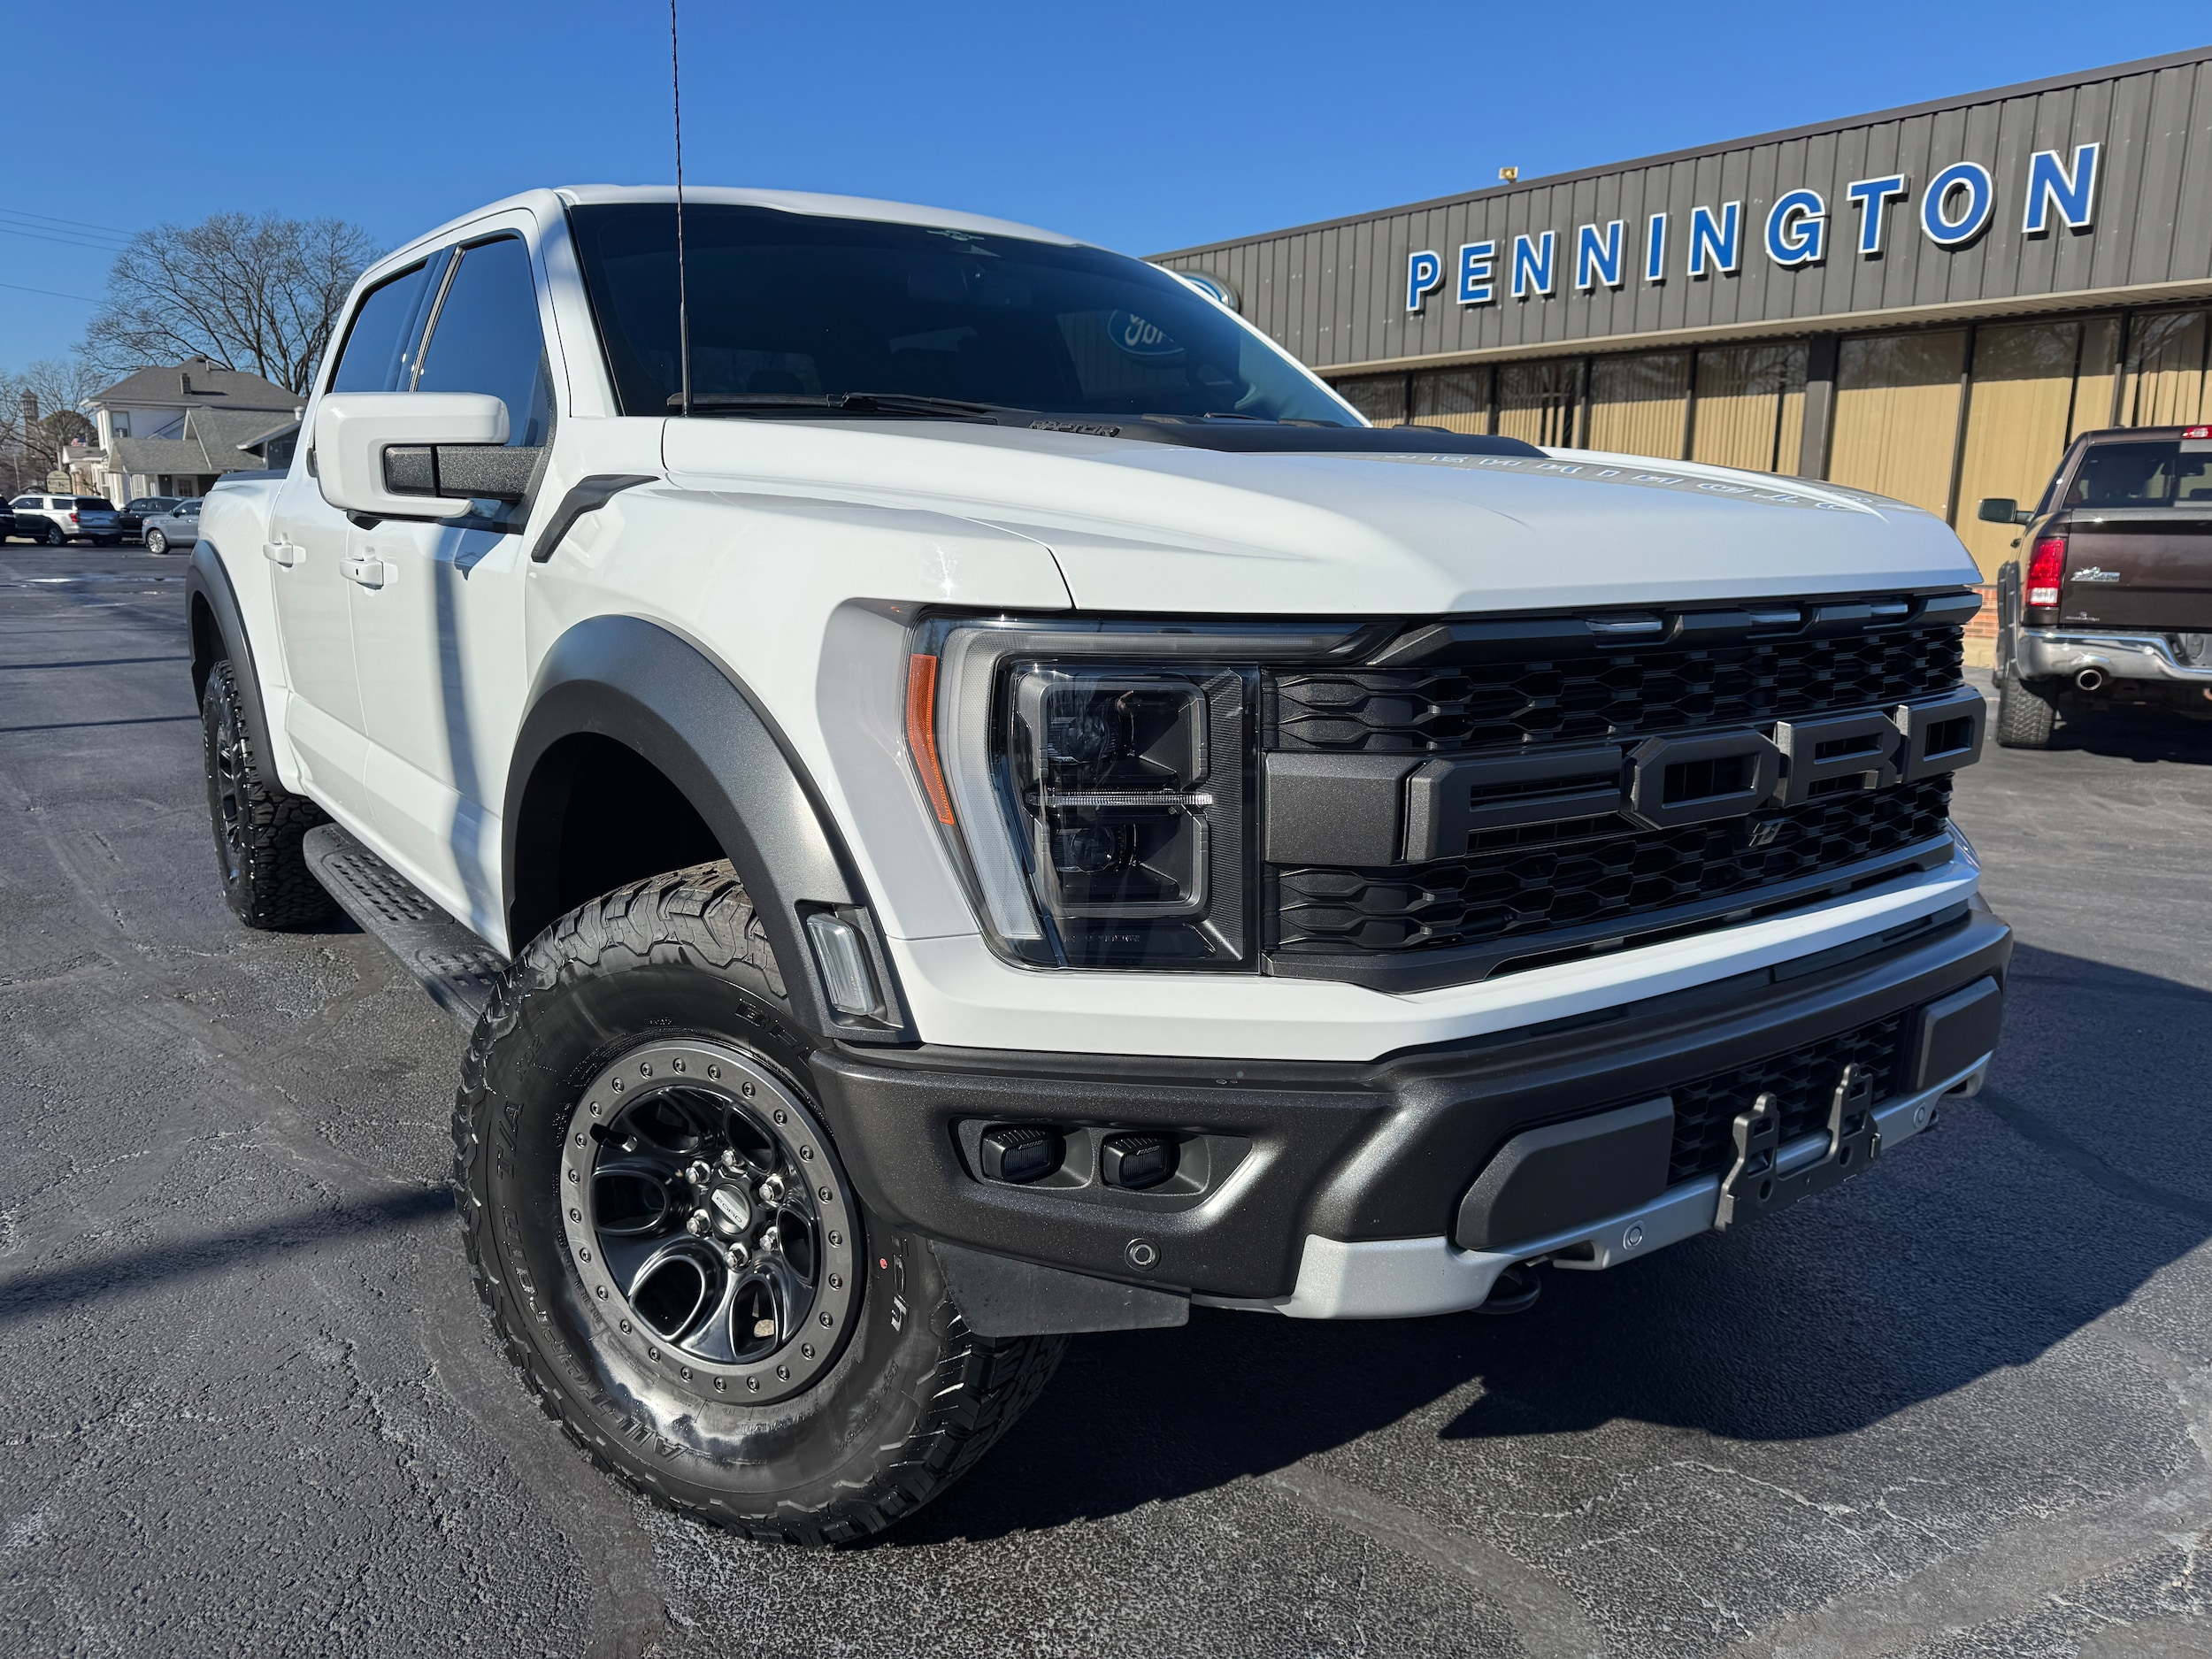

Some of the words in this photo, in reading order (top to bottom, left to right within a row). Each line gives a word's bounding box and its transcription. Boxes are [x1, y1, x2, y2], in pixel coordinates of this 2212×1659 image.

[1407, 142, 2101, 312] PENNINGTON
[1028, 420, 1121, 437] RAPTOR
[1406, 686, 1987, 863] FORD
[1018, 1140, 1043, 1150] RIGID
[716, 1196, 742, 1223] FORD
